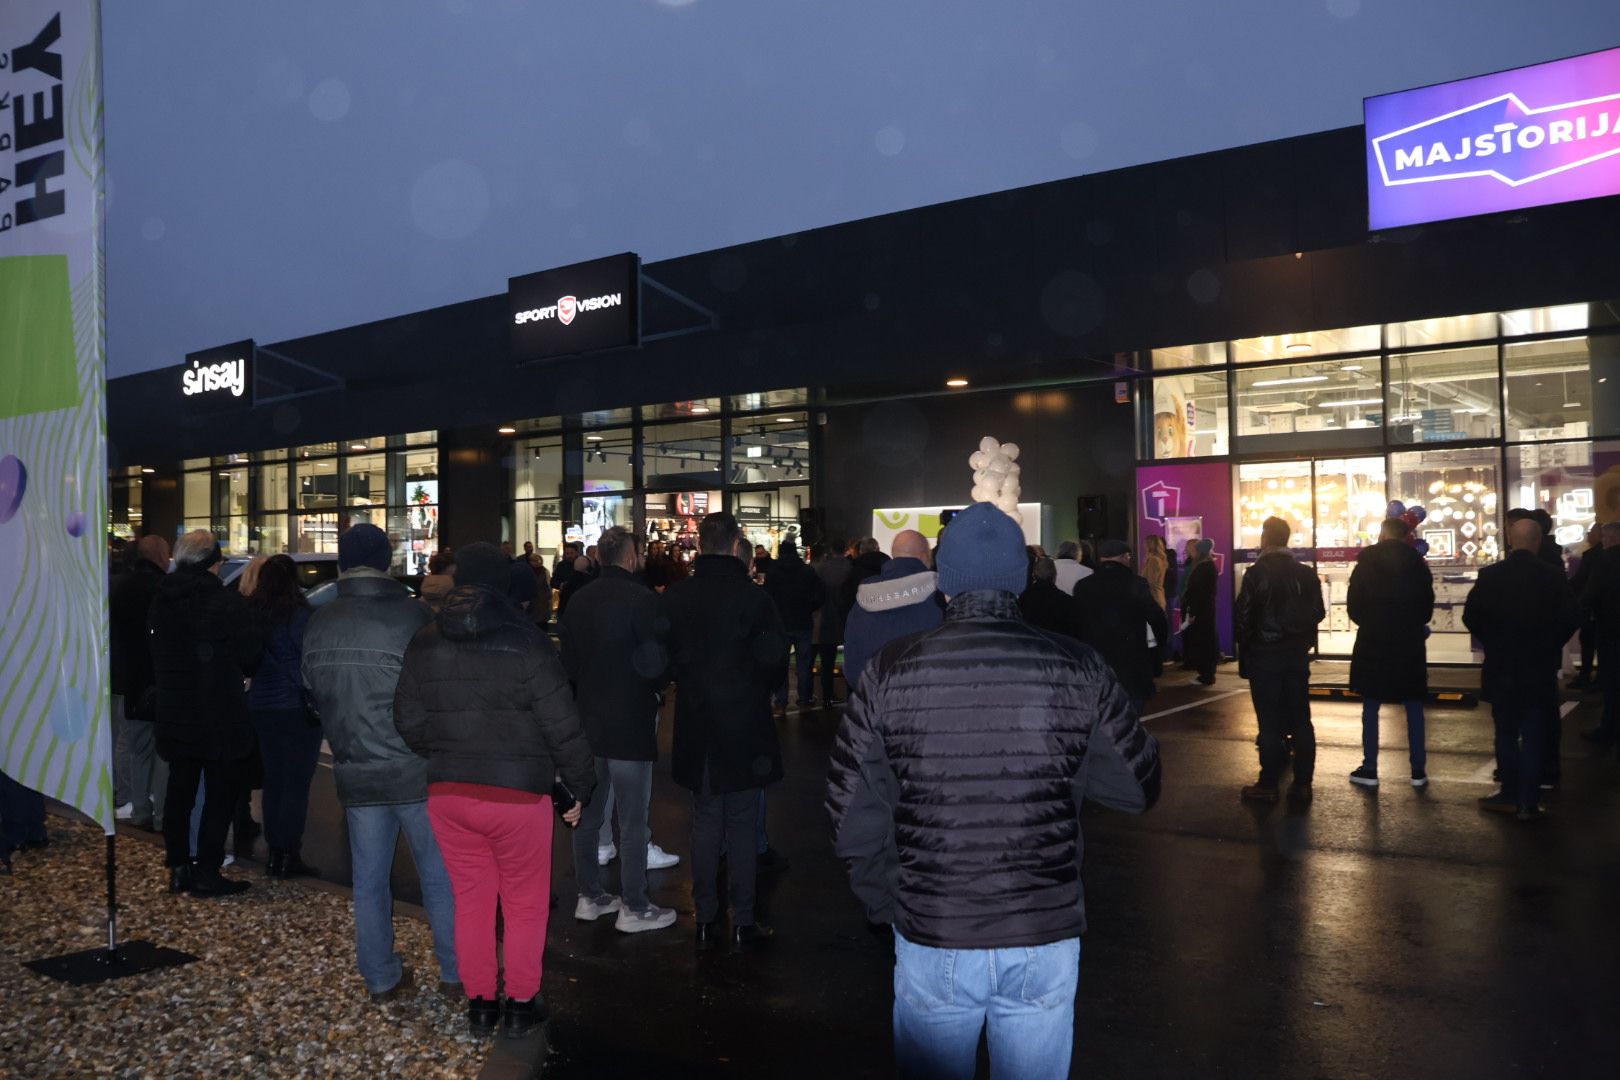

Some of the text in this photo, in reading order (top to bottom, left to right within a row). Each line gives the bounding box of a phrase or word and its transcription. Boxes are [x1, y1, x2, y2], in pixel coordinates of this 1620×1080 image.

[515, 293, 621, 325] SPORT VISION
[183, 359, 245, 396] sinsay
